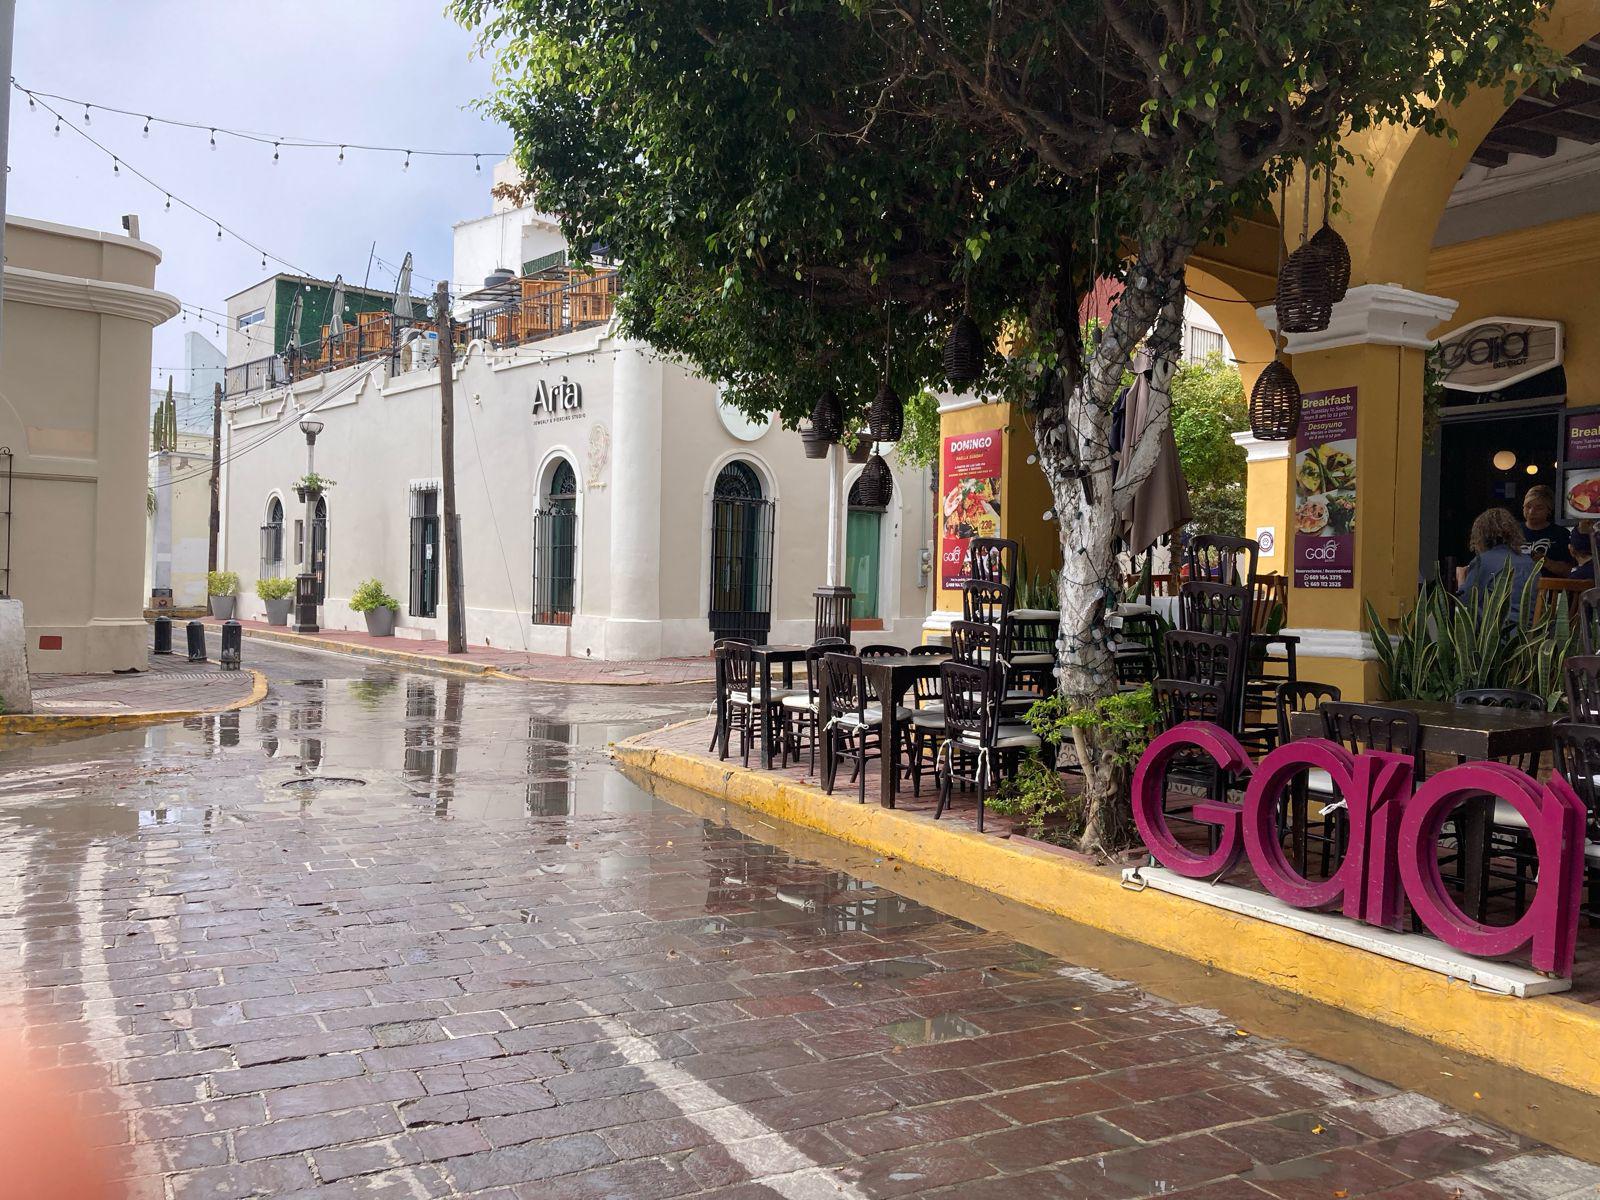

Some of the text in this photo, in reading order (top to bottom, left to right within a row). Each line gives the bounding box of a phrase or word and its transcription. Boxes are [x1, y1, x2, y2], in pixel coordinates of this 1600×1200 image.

[532, 375, 582, 414] Aria
[1302, 394, 1351, 409] Breakfast
[1308, 421, 1343, 431] Desayuno
[951, 437, 992, 452] DOMINGO
[1305, 546, 1336, 560] Gaia
[1131, 721, 1588, 978] Gaia
